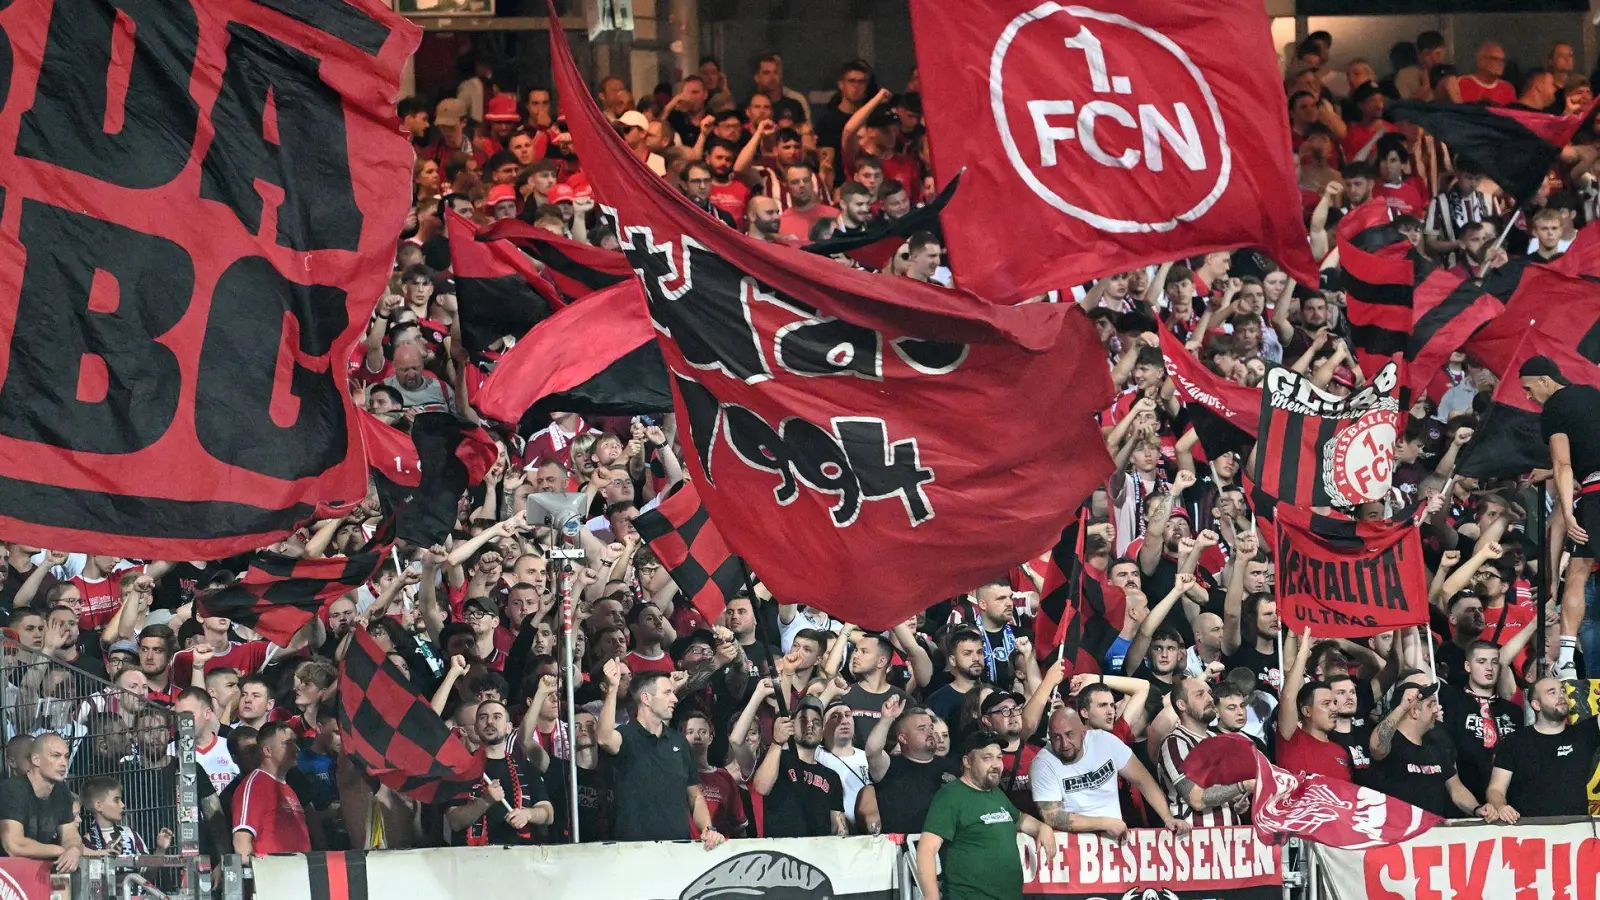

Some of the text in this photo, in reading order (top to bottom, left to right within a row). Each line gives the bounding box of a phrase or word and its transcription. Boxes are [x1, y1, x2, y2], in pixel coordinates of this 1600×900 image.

[1064, 24, 1132, 94] 1.
[1027, 99, 1207, 172] FCN
[1362, 430, 1385, 457] 1.
[1294, 604, 1378, 627] ULTRAS
[1017, 828, 1275, 884] DIE BESESSENEN
